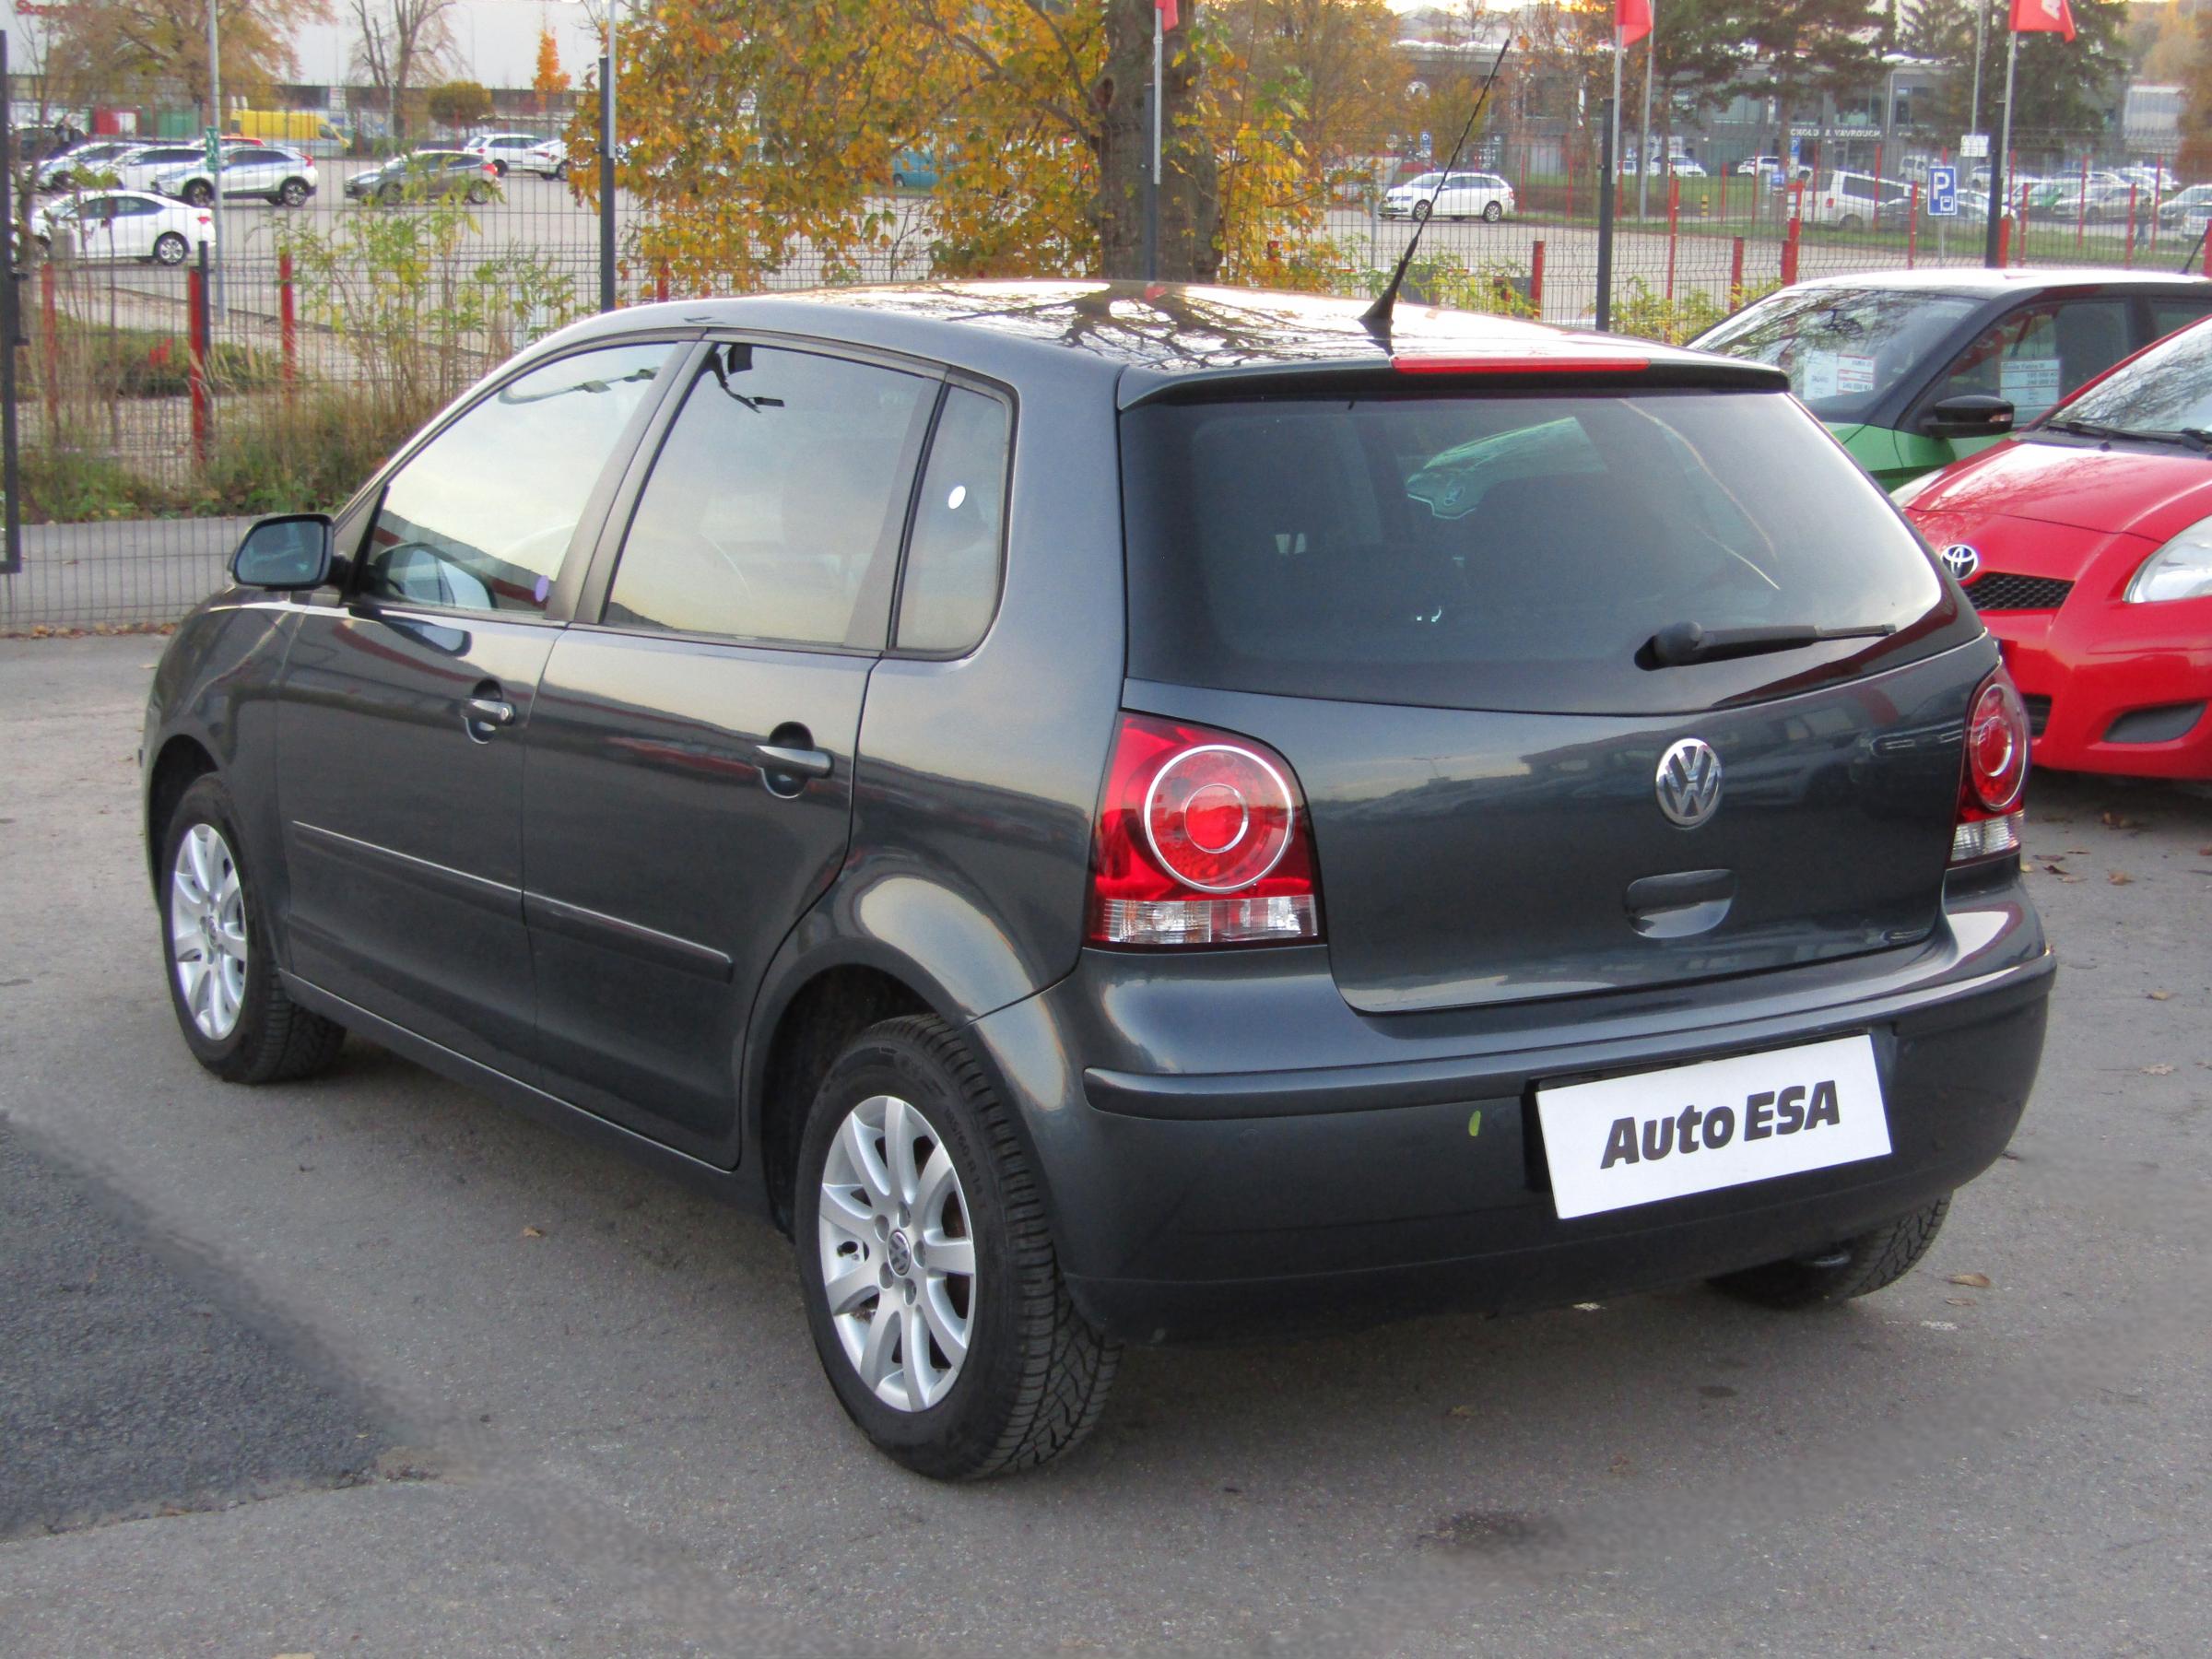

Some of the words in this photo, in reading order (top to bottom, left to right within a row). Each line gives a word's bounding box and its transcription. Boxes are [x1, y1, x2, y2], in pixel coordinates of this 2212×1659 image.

[1934, 171, 1951, 200] P
[1600, 1105, 1735, 1170] Auto
[1744, 1080, 1841, 1141] ESA
